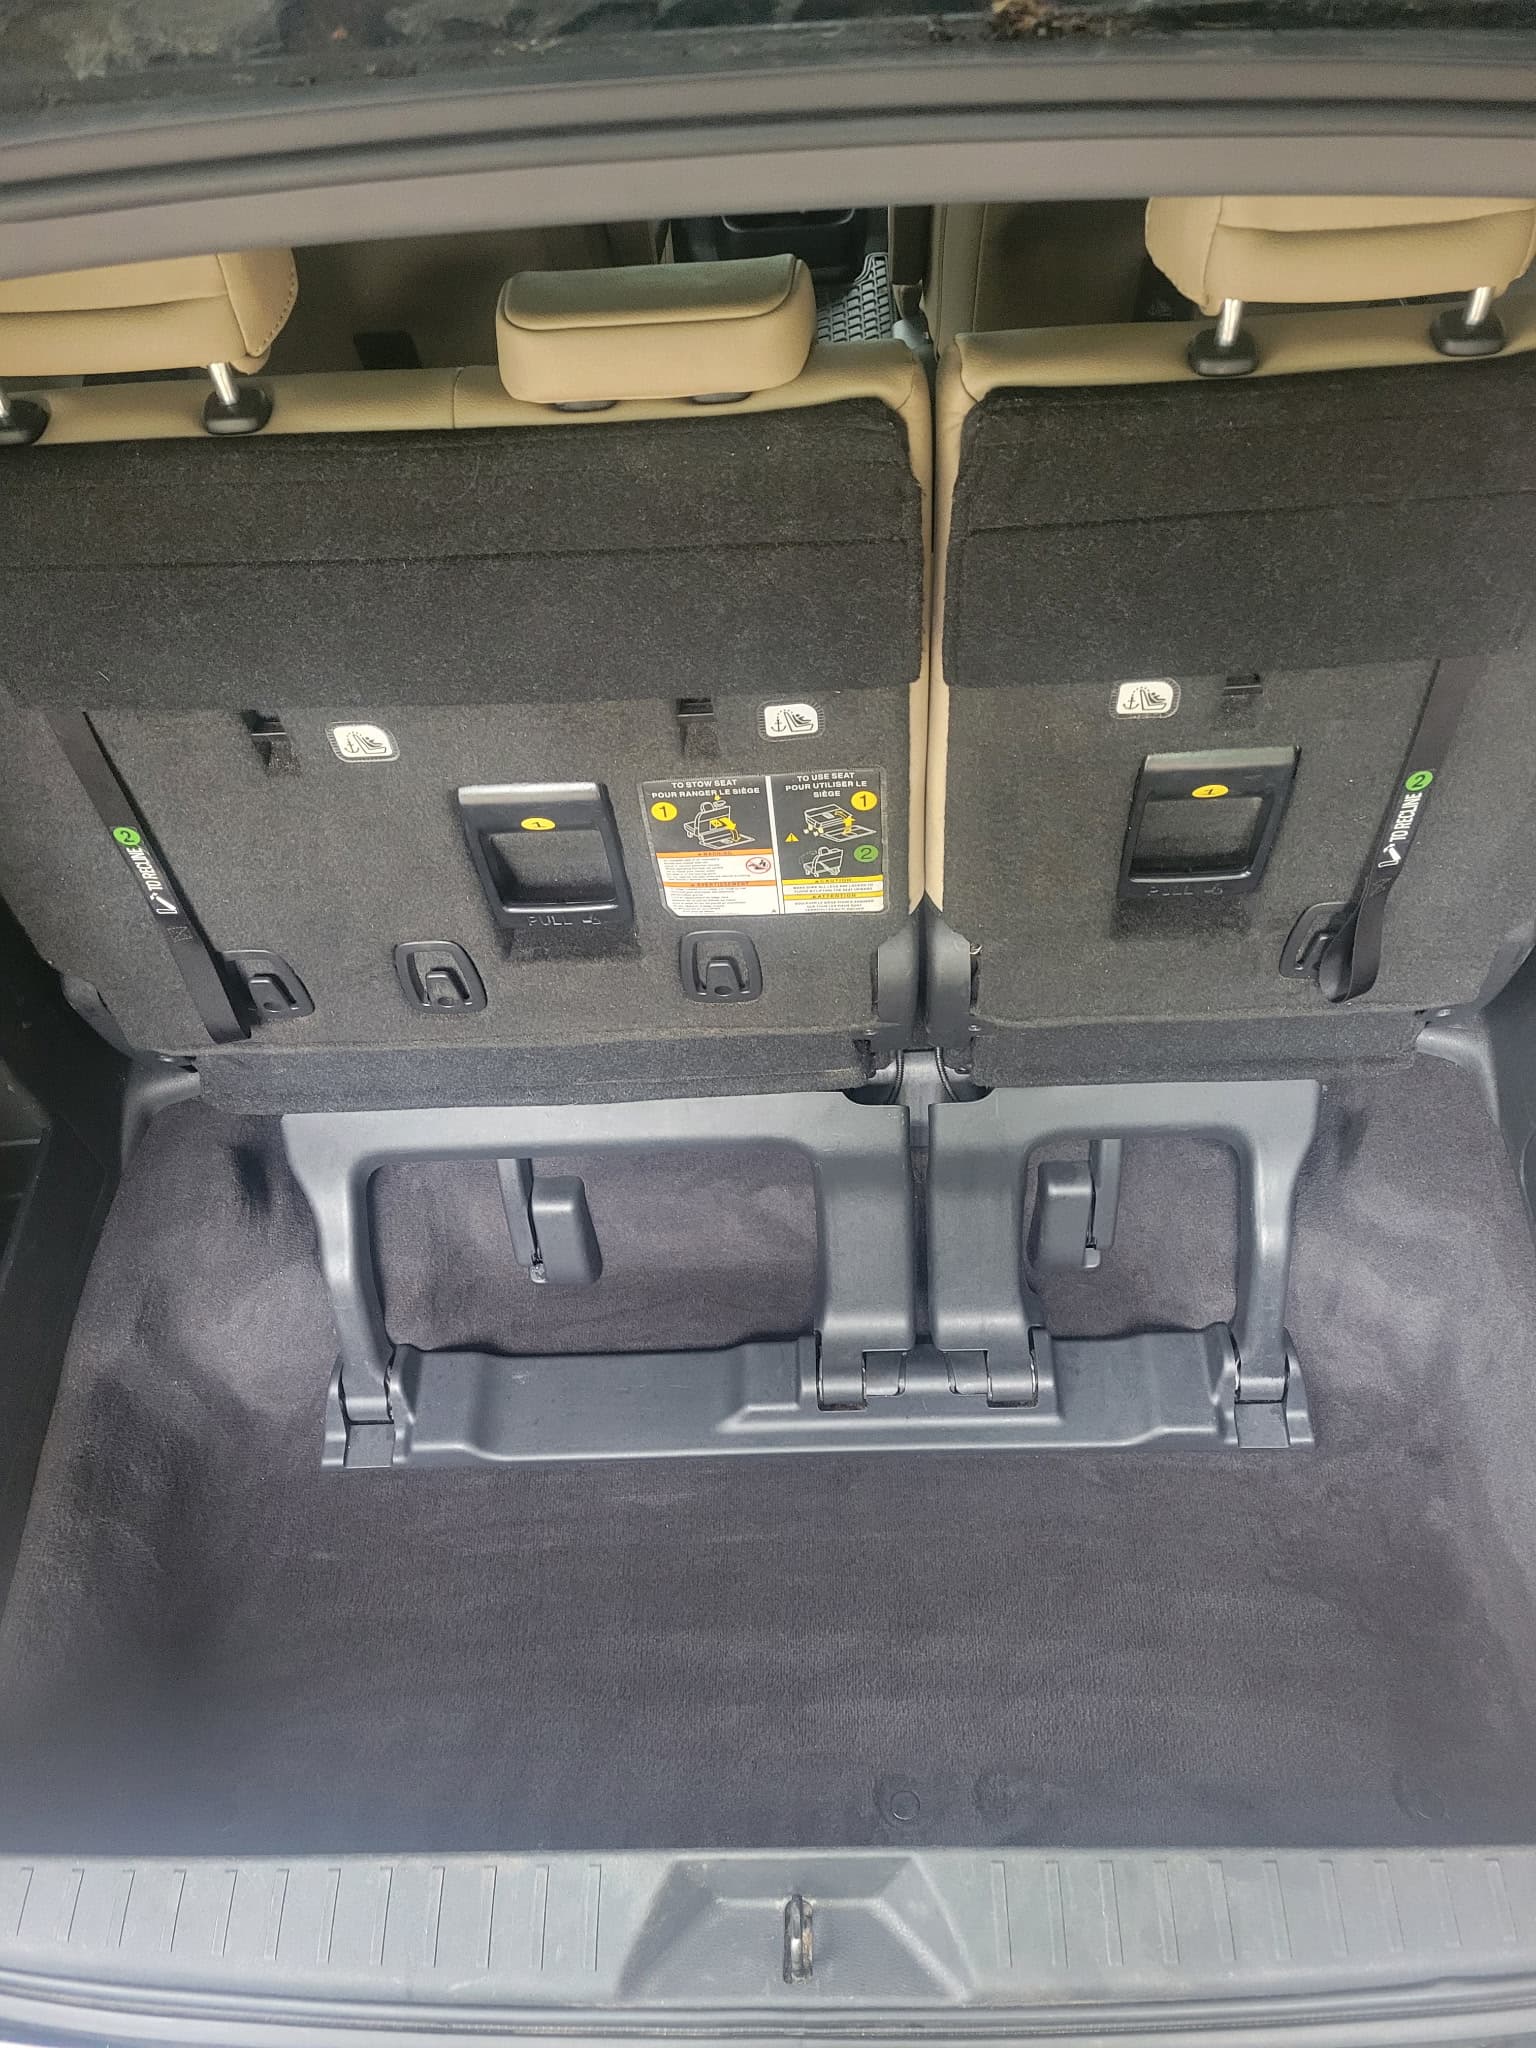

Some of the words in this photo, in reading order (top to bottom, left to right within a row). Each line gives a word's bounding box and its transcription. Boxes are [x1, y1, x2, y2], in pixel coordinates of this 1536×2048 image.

[811, 773, 829, 781] USE
[831, 771, 855, 779] SEAT
[685, 780, 712, 788] STOW
[714, 778, 737, 787] SEAT
[785, 783, 811, 791] POUR
[812, 780, 854, 790] UTILISER
[651, 791, 677, 799] POUR
[678, 789, 718, 798] RANGER
[719, 788, 731, 796] LE
[1393, 791, 1422, 830] RECLINE
[1388, 830, 1408, 842] TO
[125, 847, 159, 880] RECLINE
[145, 880, 164, 891] TO
